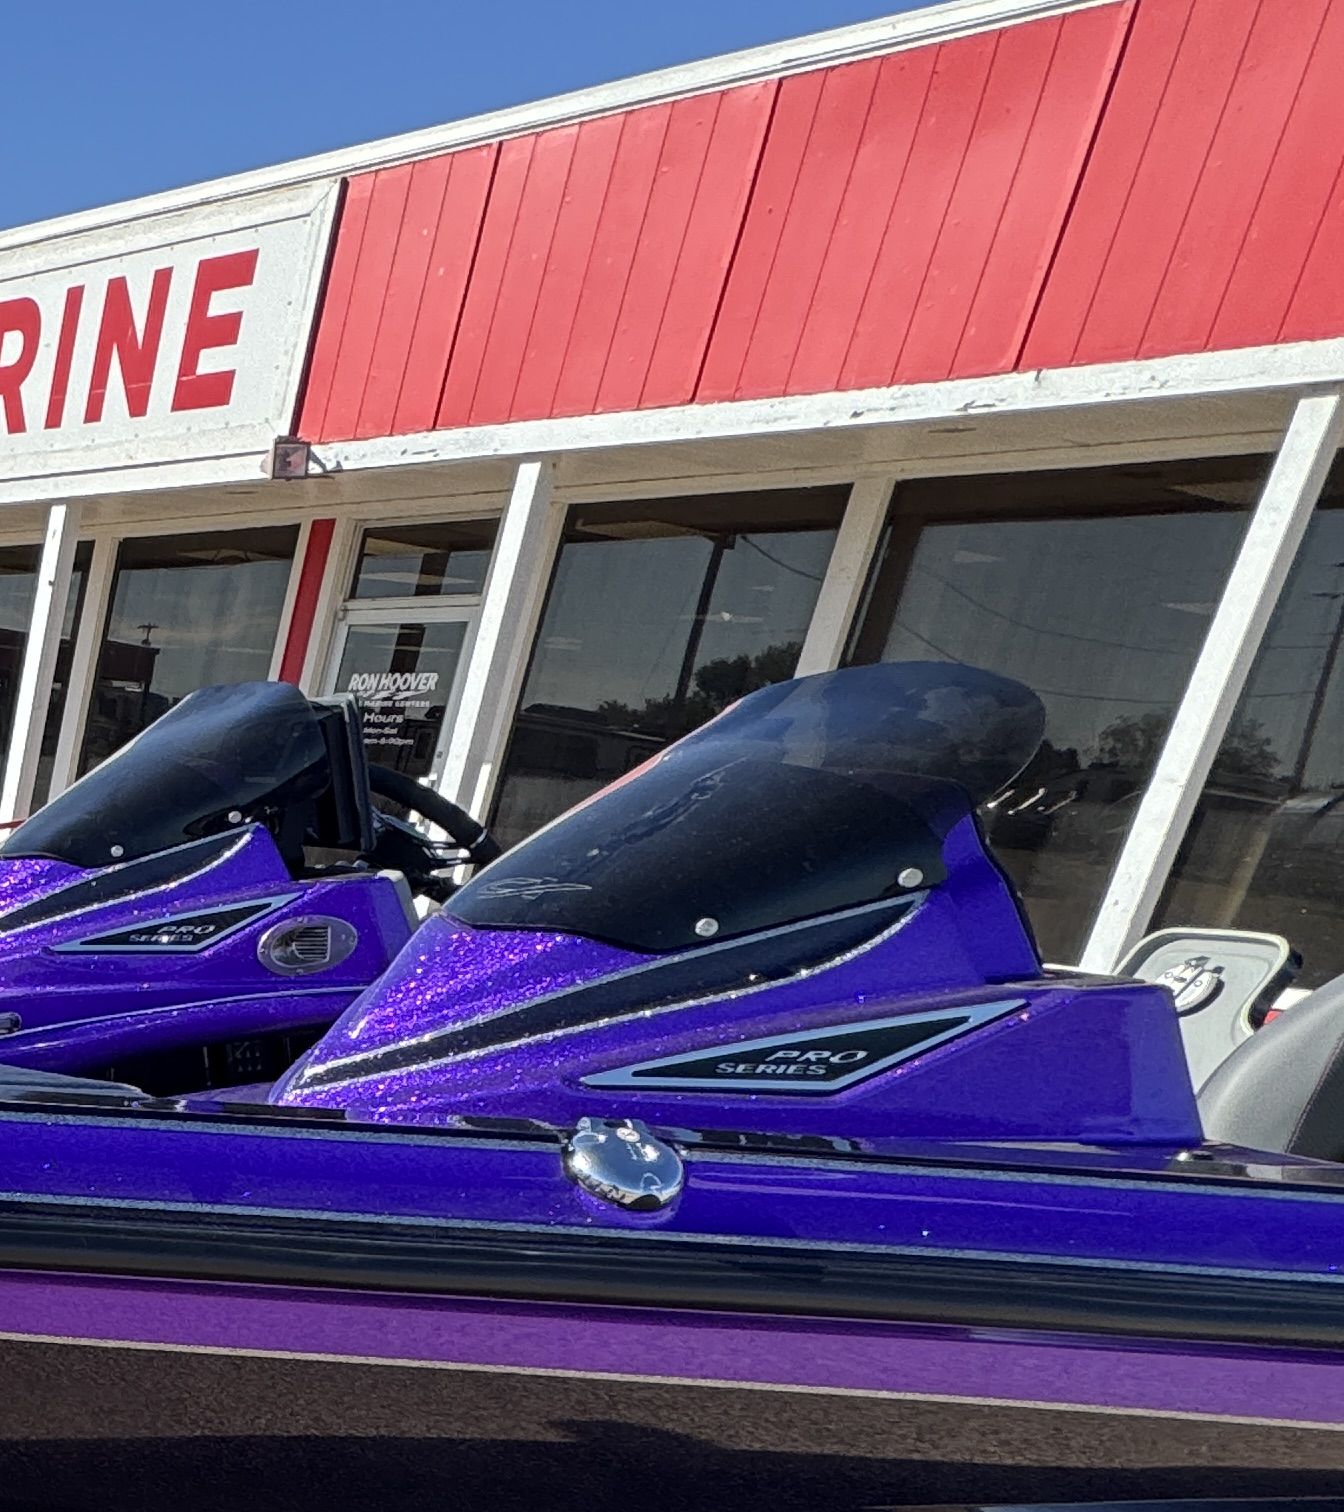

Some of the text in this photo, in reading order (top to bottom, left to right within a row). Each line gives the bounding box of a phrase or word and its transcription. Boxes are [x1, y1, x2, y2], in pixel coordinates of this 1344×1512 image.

[348, 672, 439, 691] RON HOOVER
[362, 712, 405, 723] Hours
[156, 924, 216, 935] PRO
[764, 1049, 869, 1064] PRO
[715, 1062, 828, 1075] SERIES
